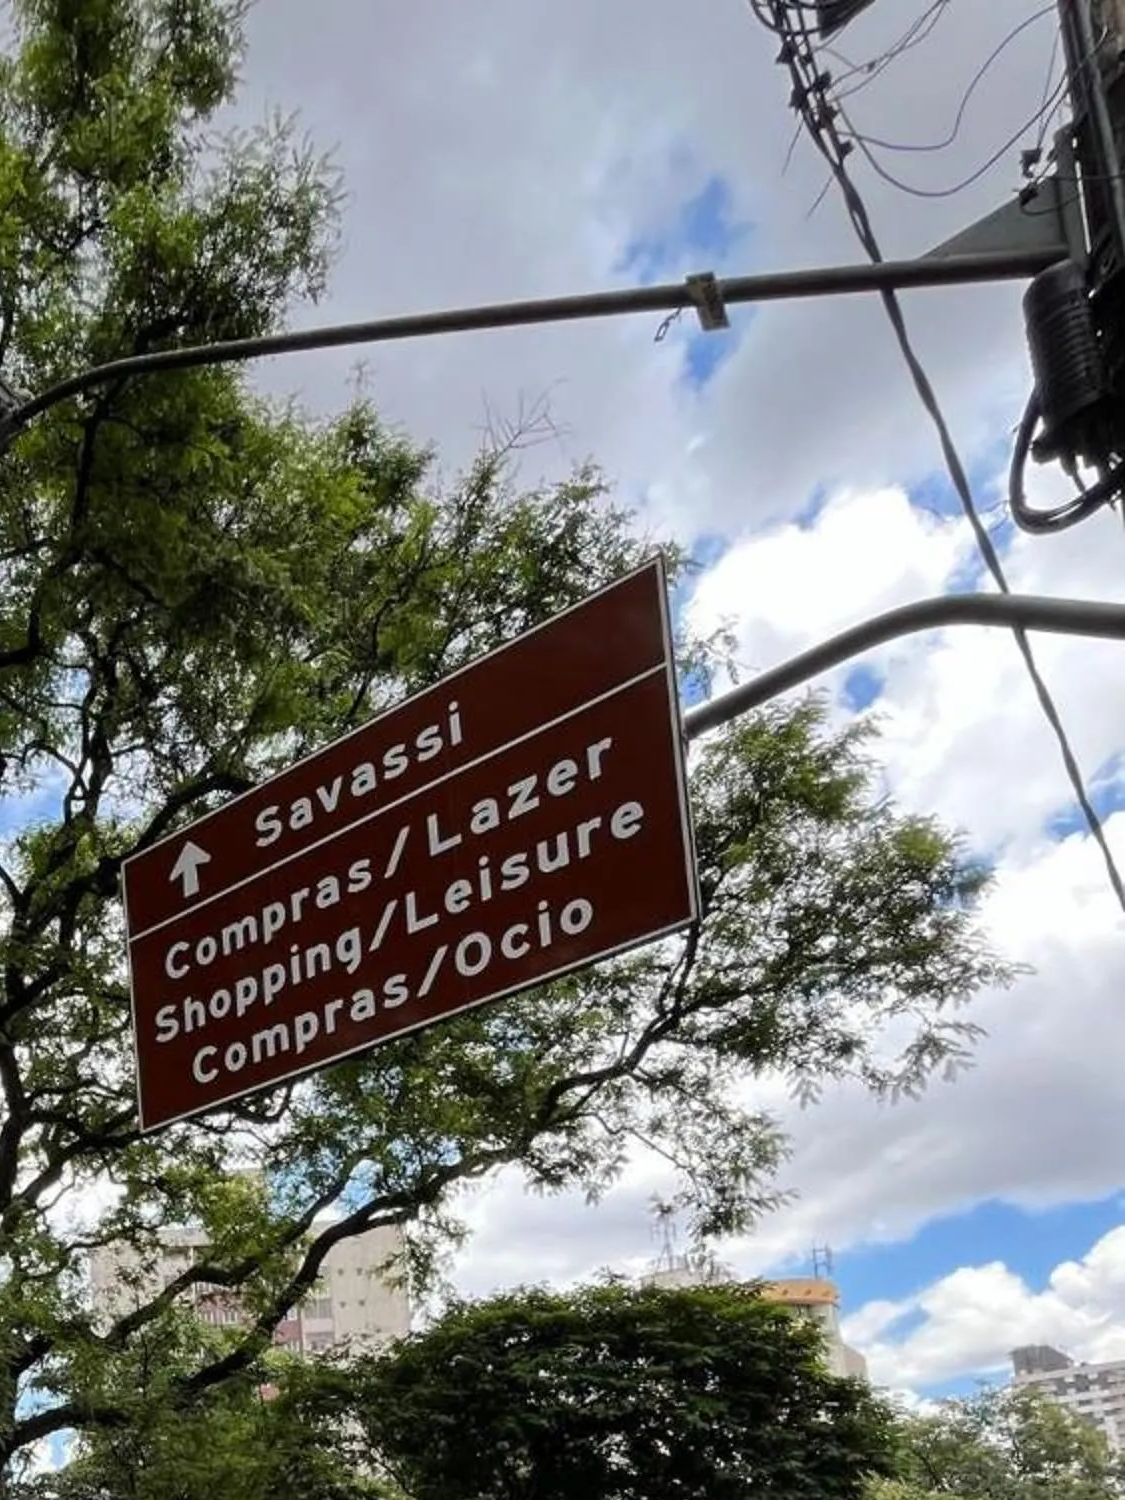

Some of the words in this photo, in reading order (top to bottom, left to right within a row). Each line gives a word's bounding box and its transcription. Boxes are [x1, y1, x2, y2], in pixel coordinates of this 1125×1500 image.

[165, 737, 612, 979] Compras/Lazer
[255, 701, 462, 847] Savassi
[155, 801, 644, 1043] Shopping/Leisure
[193, 898, 593, 1083] Compras/Ocio
